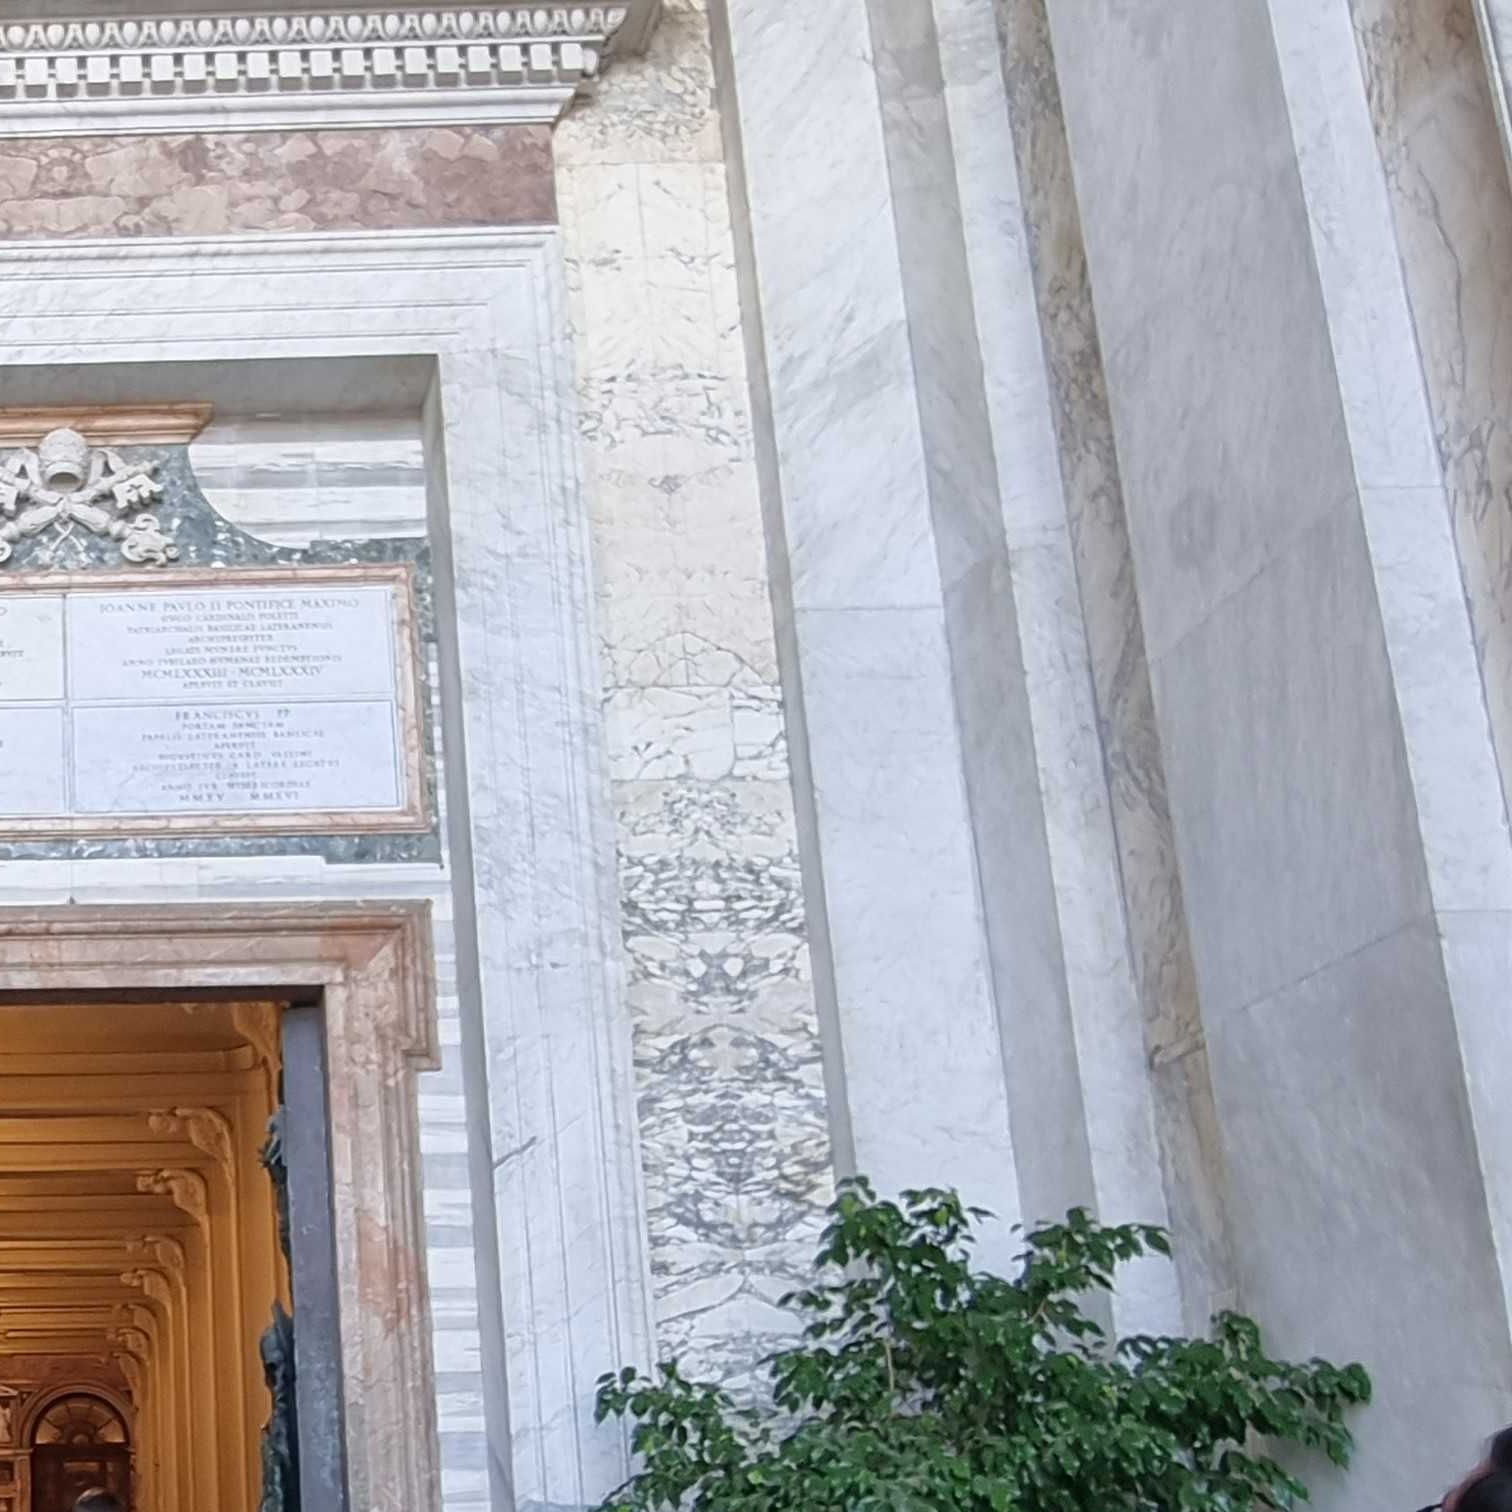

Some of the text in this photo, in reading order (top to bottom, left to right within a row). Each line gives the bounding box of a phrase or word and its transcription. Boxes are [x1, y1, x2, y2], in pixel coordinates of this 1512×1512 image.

[99, 598, 360, 614] IOANNE PAVLO II PONTIFICE MAXIMO
